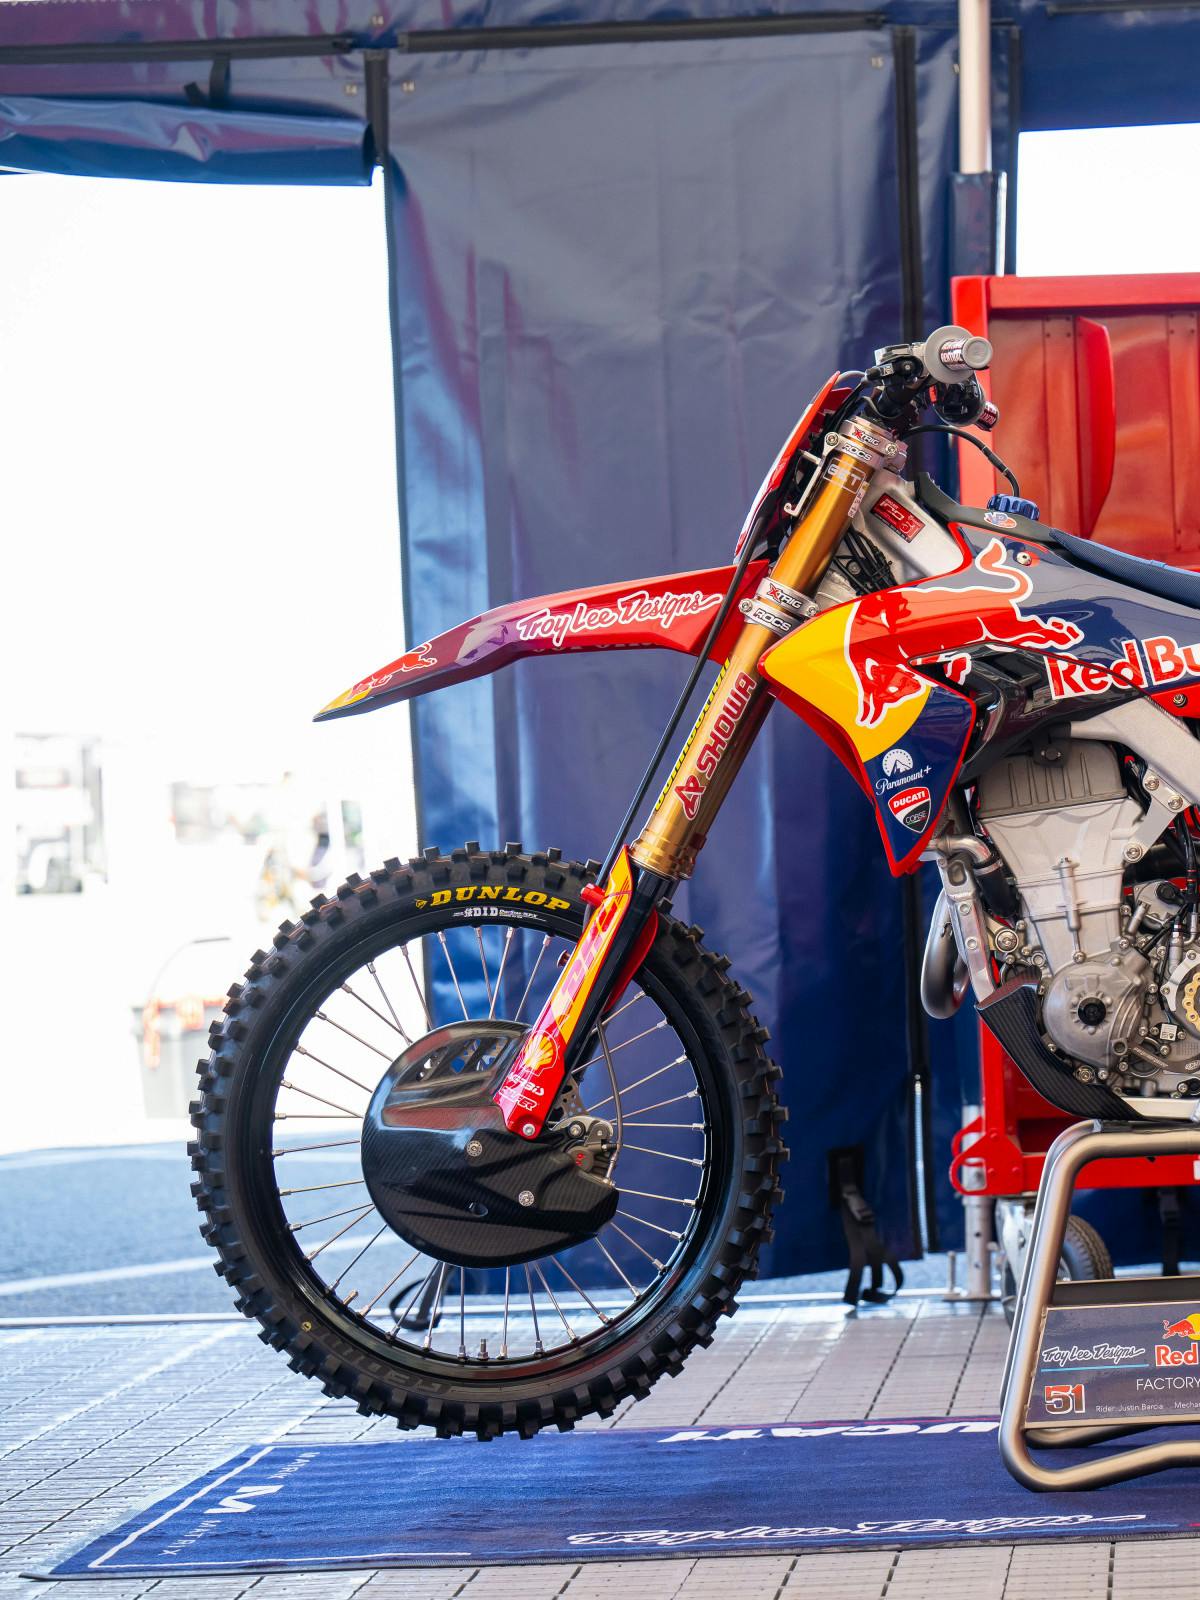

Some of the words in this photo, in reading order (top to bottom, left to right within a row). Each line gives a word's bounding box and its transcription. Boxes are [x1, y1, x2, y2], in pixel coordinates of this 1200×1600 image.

[852, 428, 880, 446] XTRIG
[842, 443, 873, 462] ROCS
[769, 583, 802, 610] XTRIG
[516, 608, 570, 646] Troy
[571, 603, 618, 633] Lee
[618, 590, 723, 628] Designs
[753, 609, 792, 633] ROCS
[1043, 639, 1148, 699] Red
[697, 672, 757, 779] SHOWA
[893, 790, 926, 809] DUCATI
[905, 810, 927, 824] CORSE
[430, 885, 571, 911] DUNLOP
[1042, 1346, 1071, 1367] Troy
[1069, 1345, 1093, 1361] Lee
[1092, 1342, 1146, 1365] Designs
[1155, 1342, 1199, 1367] Red
[1045, 1383, 1085, 1415] 51
[657, 1421, 1000, 1443] UCATI
